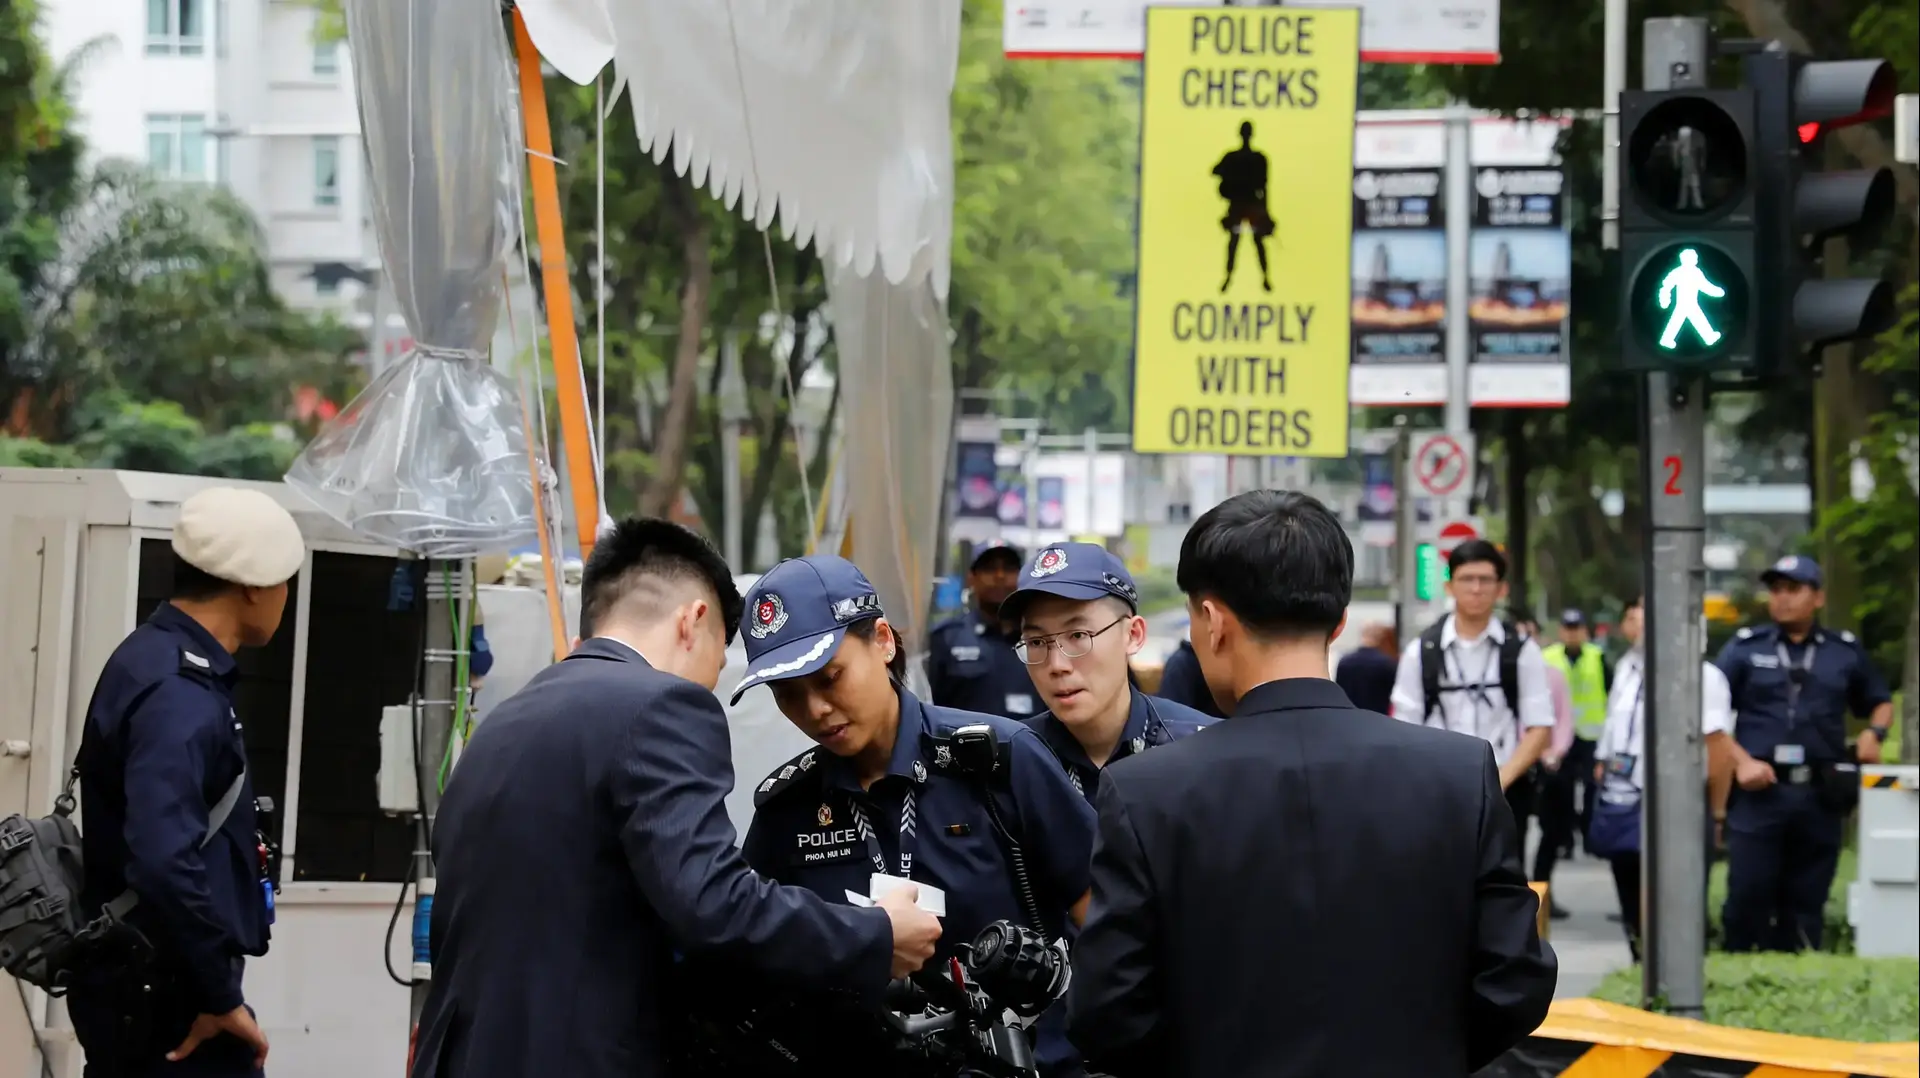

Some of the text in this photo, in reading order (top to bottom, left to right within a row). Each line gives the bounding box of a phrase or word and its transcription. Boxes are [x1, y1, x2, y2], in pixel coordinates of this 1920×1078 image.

[1191, 15, 1315, 55] POLICE
[1182, 68, 1319, 108] CHECKS
[1172, 303, 1315, 343] COMPLY
[1197, 355, 1286, 395] WITH
[1170, 406, 1312, 449] ORDERS
[1663, 455, 1684, 496] 2
[797, 829, 857, 848] POLICE
[805, 847, 852, 862] PHOA HUI LIN
[872, 853, 888, 875] ICE
[900, 852, 912, 879] LICE
